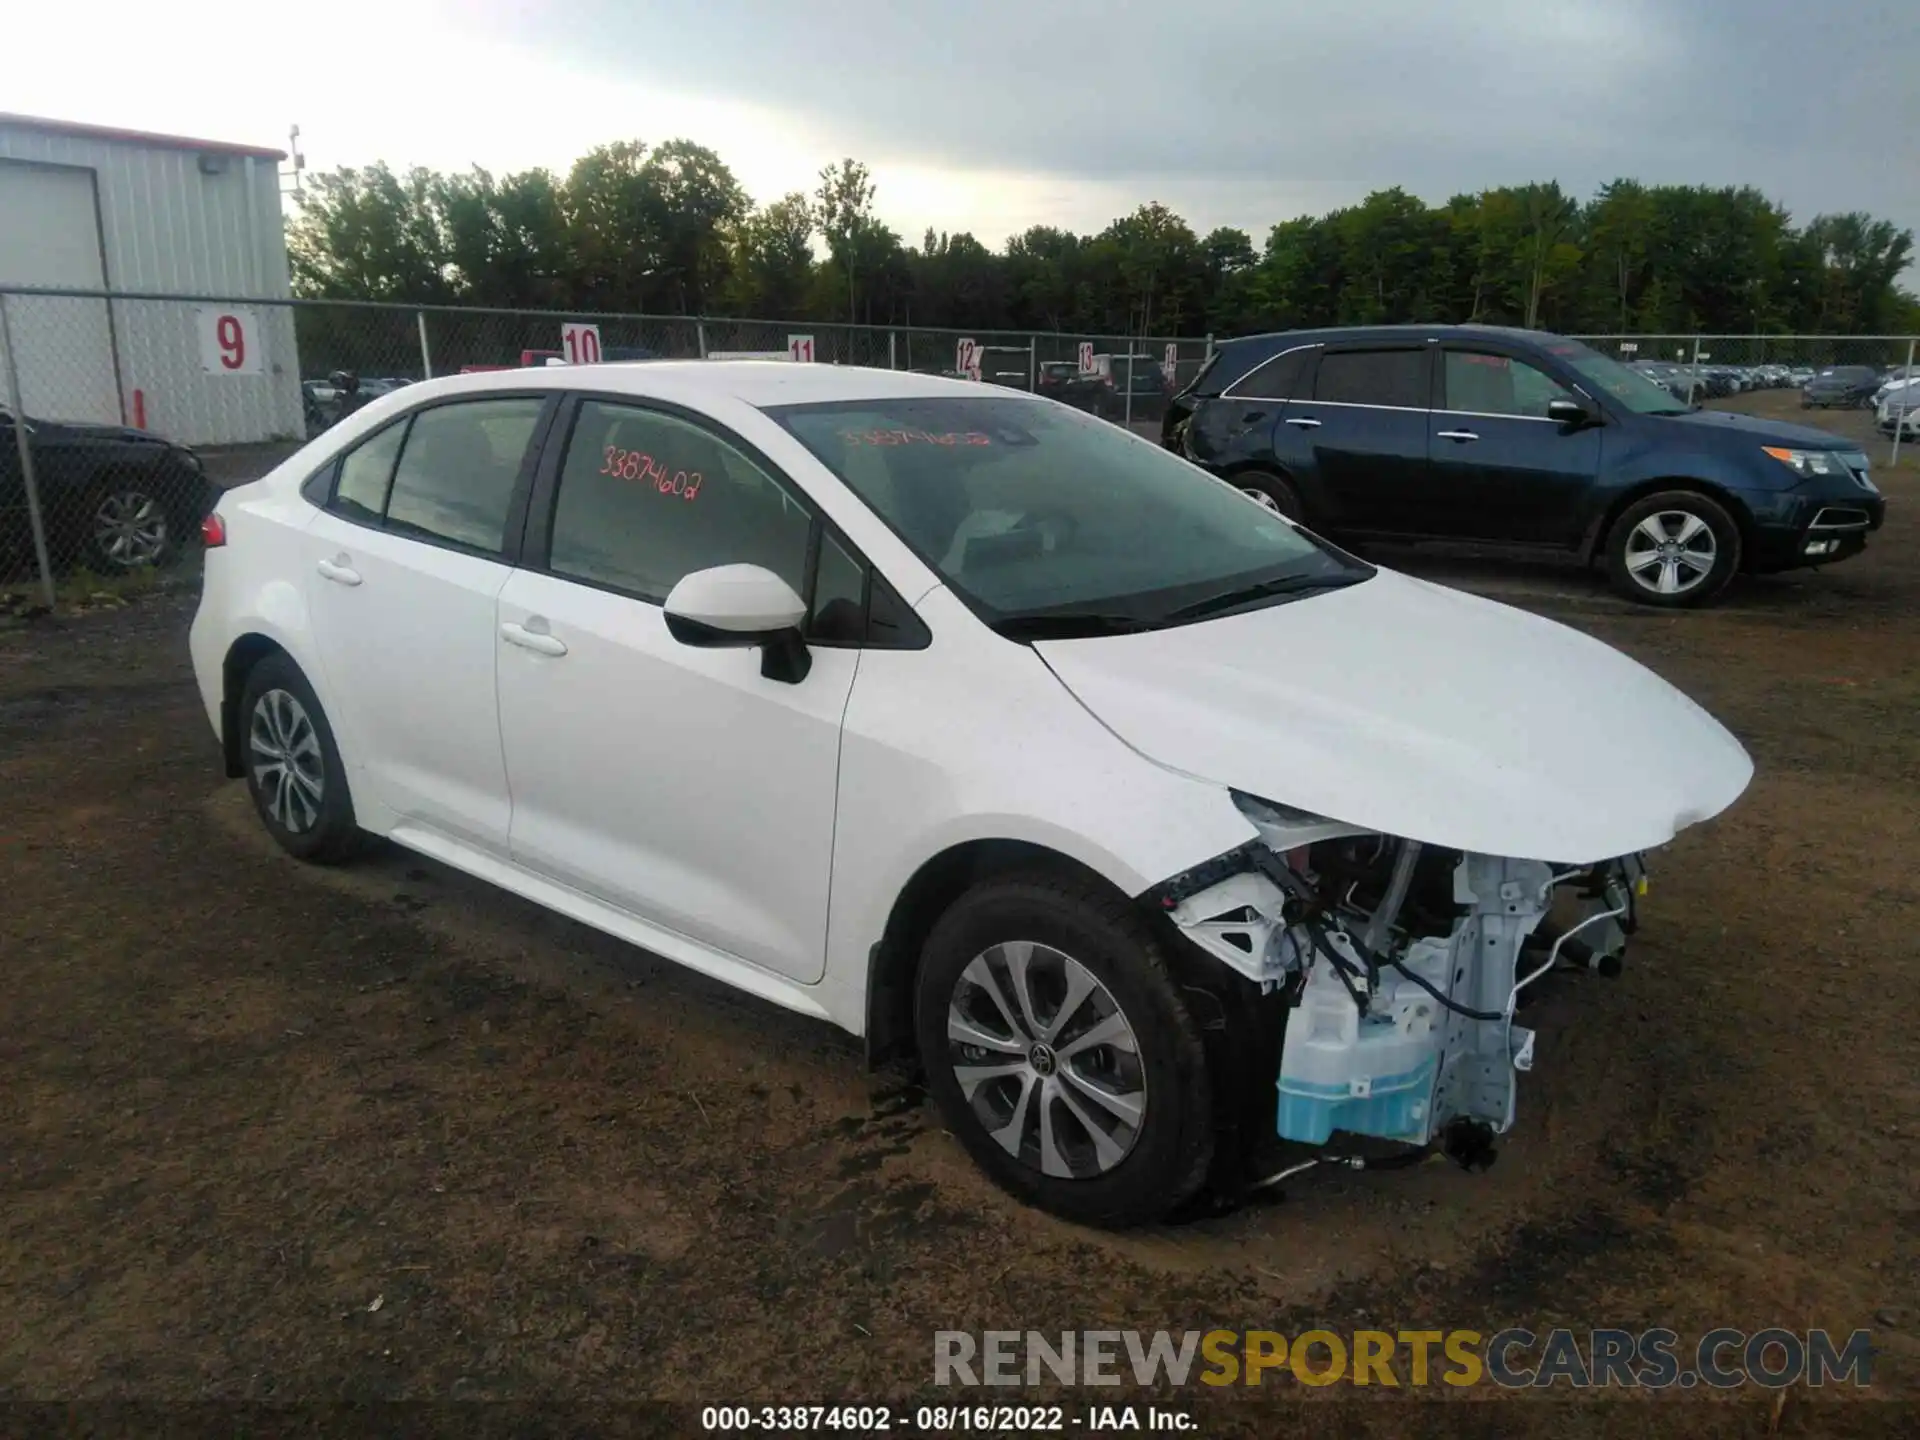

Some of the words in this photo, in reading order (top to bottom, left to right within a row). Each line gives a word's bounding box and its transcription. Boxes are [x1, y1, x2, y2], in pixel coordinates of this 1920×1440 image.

[217, 315, 244, 369] 9
[566, 329, 599, 364] 10
[791, 339, 811, 362] 11
[959, 342, 973, 370] 12
[1081, 345, 1092, 371] 13
[600, 445, 702, 500] 33874602
